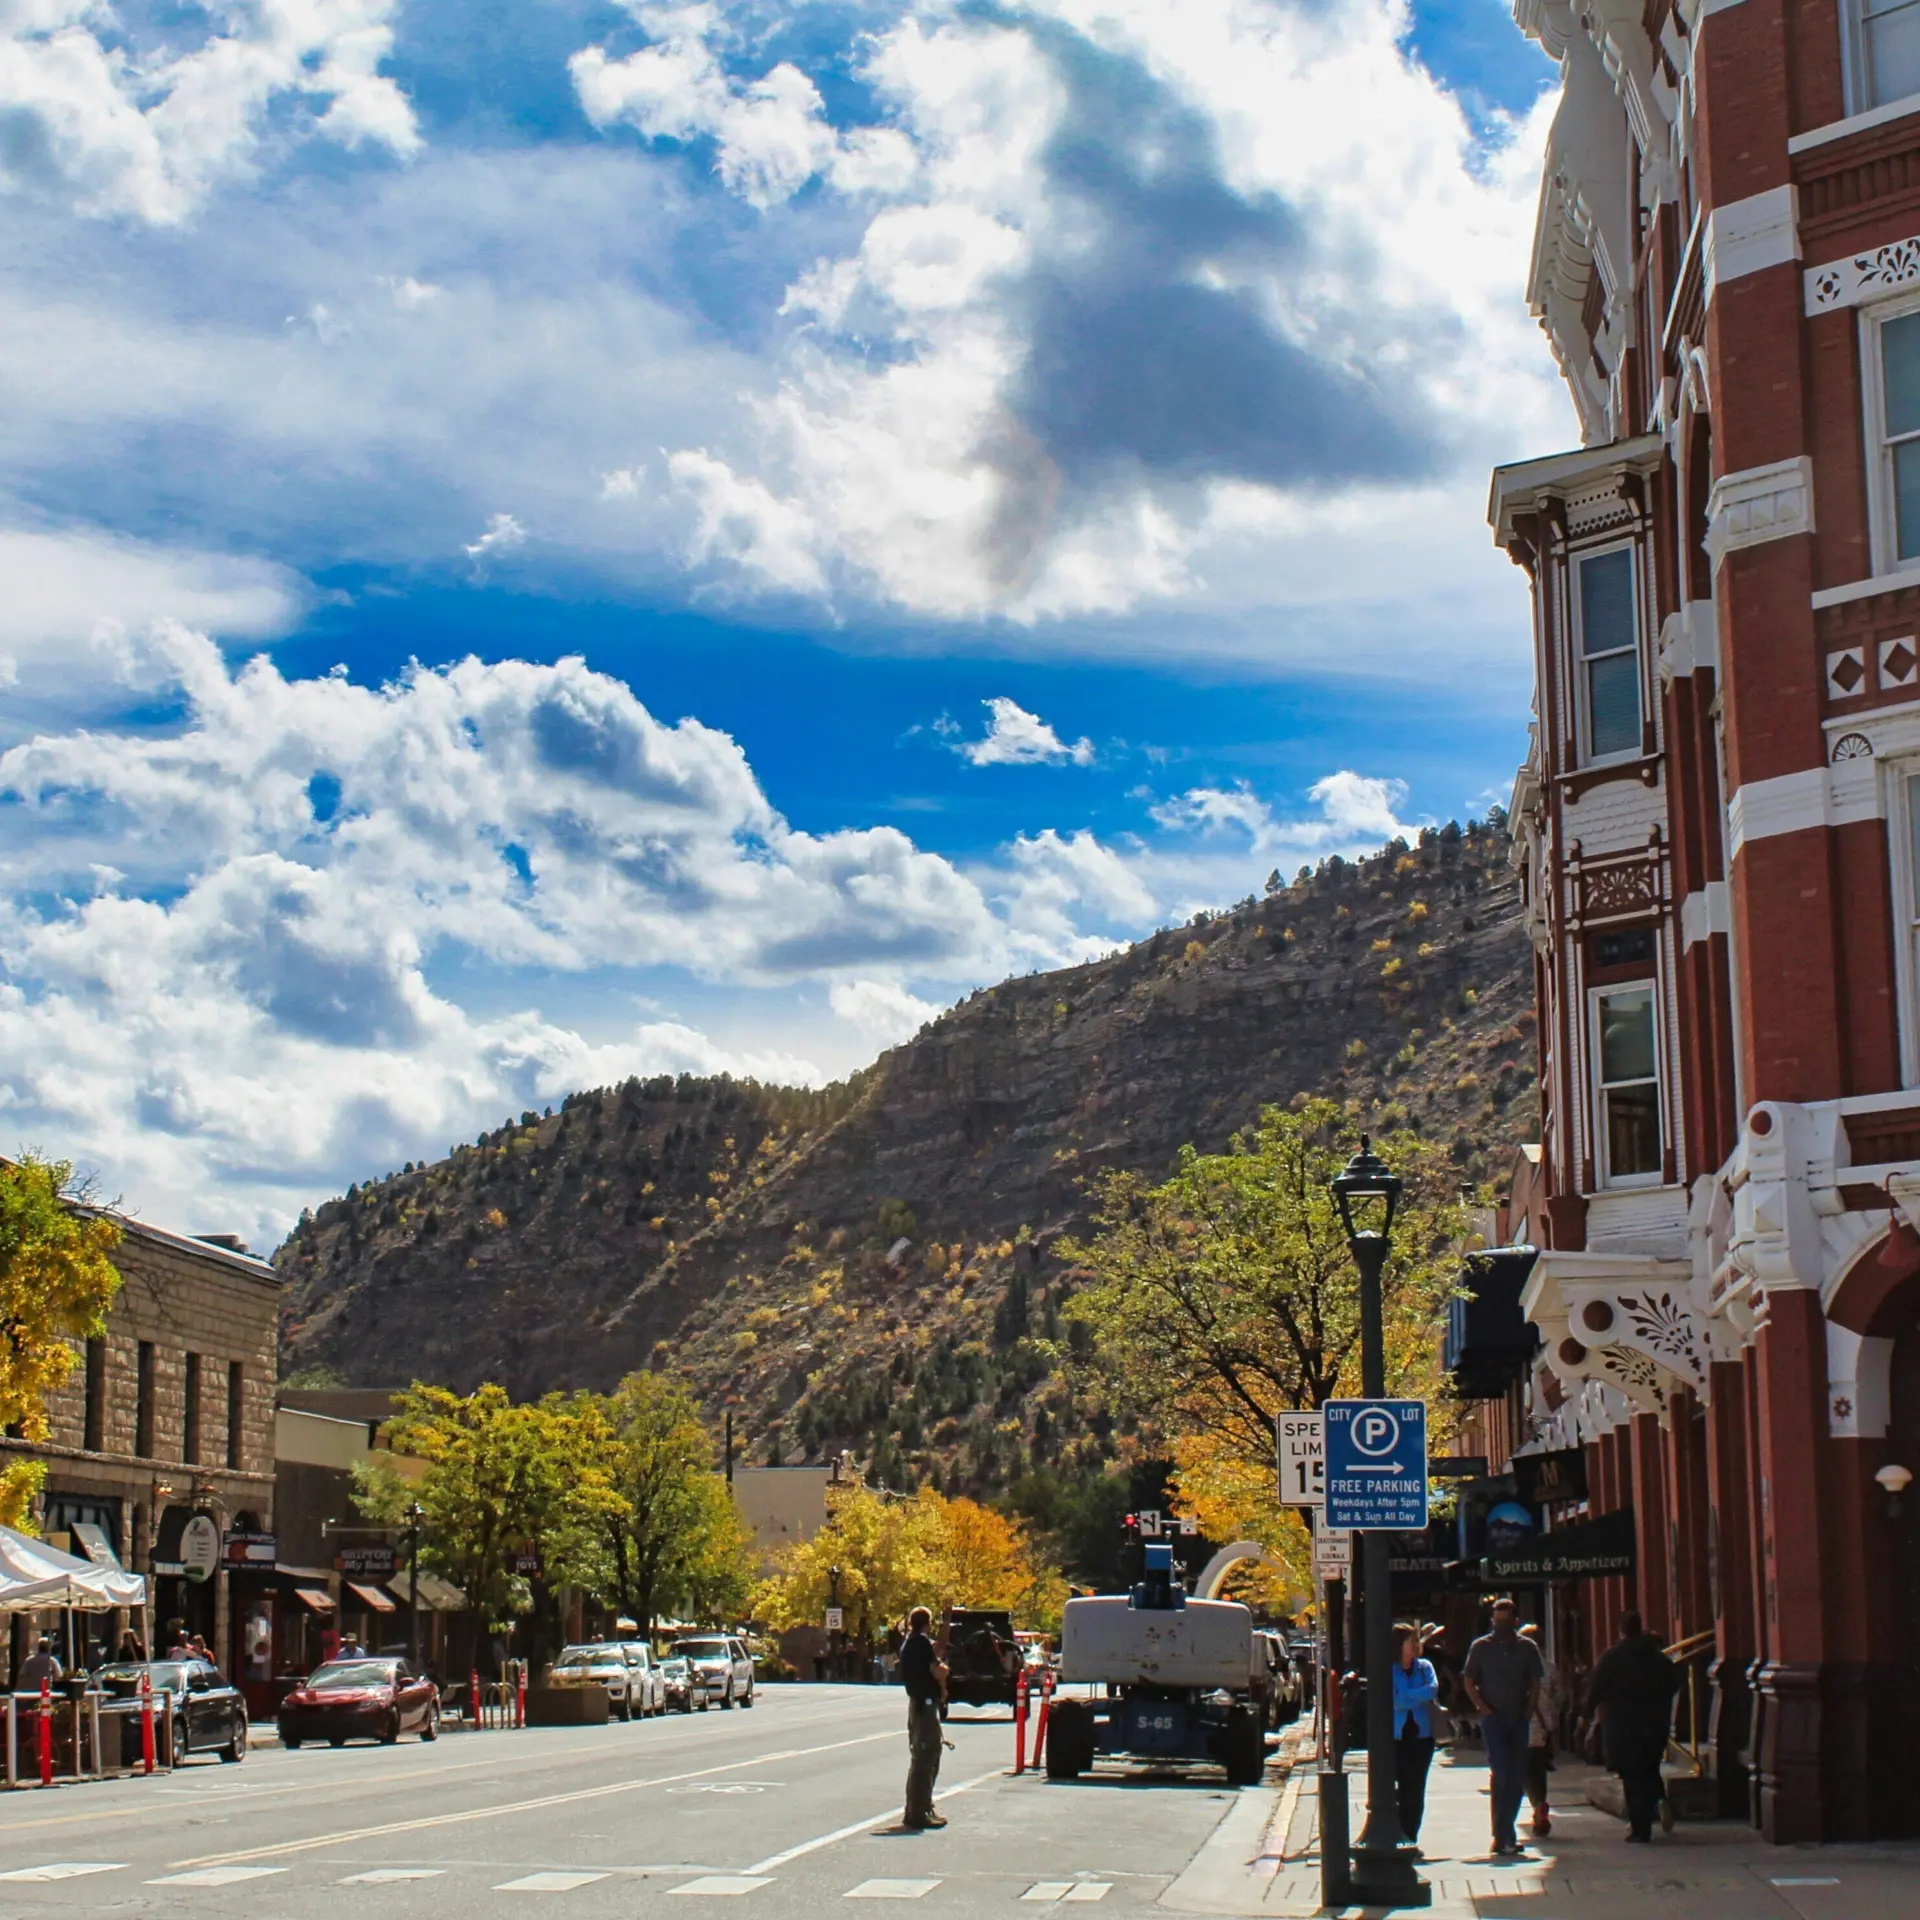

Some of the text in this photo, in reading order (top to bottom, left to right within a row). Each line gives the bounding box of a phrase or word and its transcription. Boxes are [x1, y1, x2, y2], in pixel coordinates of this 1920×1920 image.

[1328, 1408, 1351, 1421] CITY
[1401, 1408, 1421, 1421] LOT
[1285, 1423, 1320, 1436] SPE
[1365, 1418, 1386, 1445] P
[1291, 1442, 1322, 1456] LIM
[1331, 1480, 1421, 1493] FREE PARKING
[1332, 1497, 1420, 1508] Weekdays After 5pm
[1337, 1512, 1416, 1523] Sat & Sun All Day
[1494, 1560, 1538, 1575] Spirits
[1542, 1558, 1553, 1571] &
[1556, 1555, 1630, 1572] Appetizers
[1138, 1716, 1173, 1729] S-65
